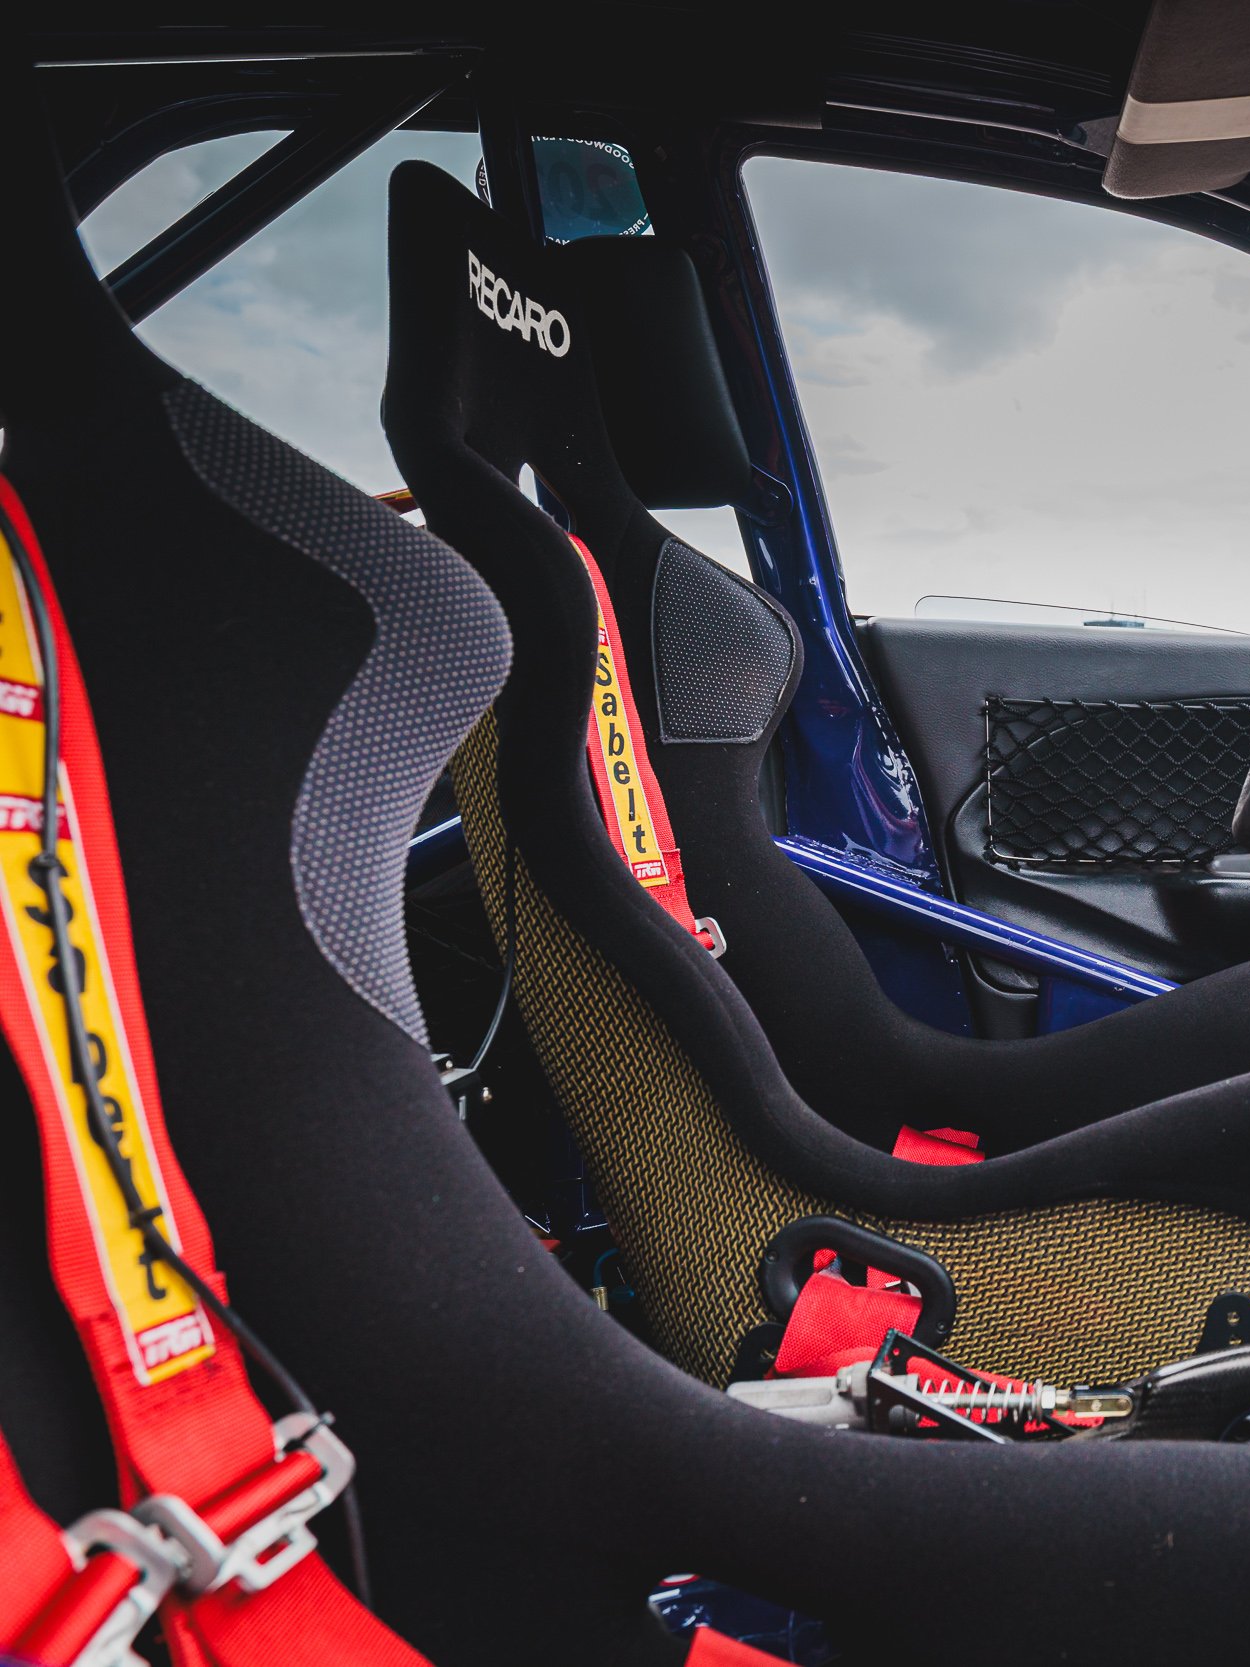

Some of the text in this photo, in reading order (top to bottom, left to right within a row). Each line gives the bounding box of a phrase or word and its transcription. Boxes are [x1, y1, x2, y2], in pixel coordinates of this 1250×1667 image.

[468, 249, 570, 357] RECARO
[596, 653, 646, 854] Sabelt
[634, 862, 662, 878] TRW
